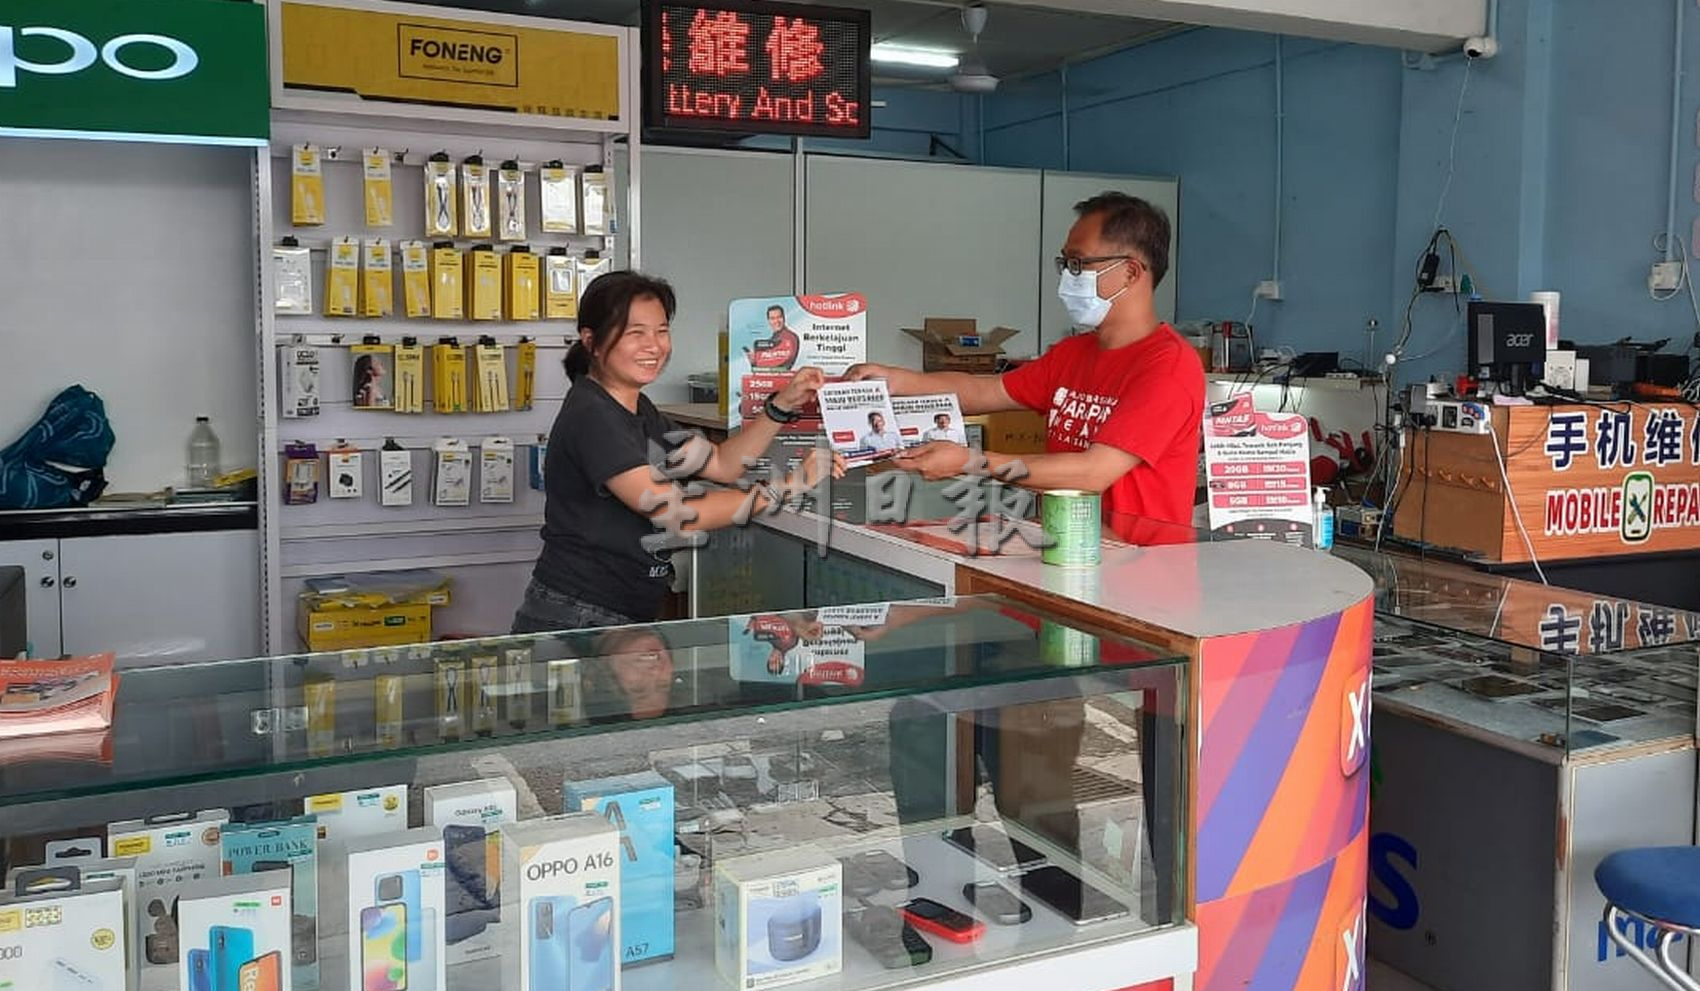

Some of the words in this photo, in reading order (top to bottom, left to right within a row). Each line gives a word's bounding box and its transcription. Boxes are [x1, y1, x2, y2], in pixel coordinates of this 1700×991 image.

[410, 38, 503, 64] FONENG
[662, 10, 825, 80] 維修
[752, 87, 813, 120] And
[809, 300, 844, 311] hotlink
[812, 323, 850, 331] Internet
[803, 333, 859, 343] Berkelajuan
[1506, 333, 1534, 347] acer
[817, 344, 846, 353] Tinggi
[1546, 410, 1700, 468] 手机维
[1546, 490, 1621, 534] MOBILE
[228, 844, 270, 858] POWER
[272, 839, 309, 852] BANK
[527, 857, 578, 881] OPPO
[583, 852, 614, 872] A16
[625, 943, 650, 959] A57
